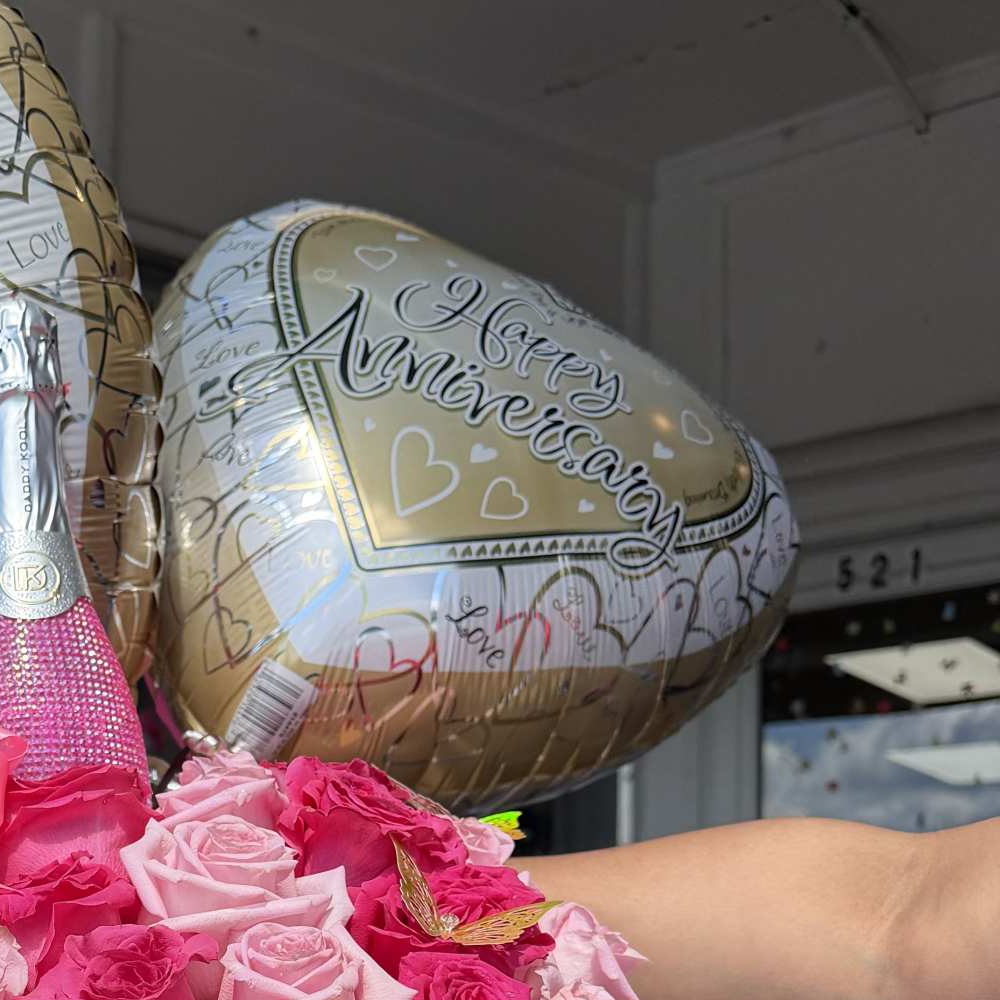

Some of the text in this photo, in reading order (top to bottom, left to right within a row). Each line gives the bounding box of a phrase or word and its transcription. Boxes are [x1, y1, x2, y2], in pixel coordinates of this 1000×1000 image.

[7, 220, 71, 270] Love
[394, 276, 630, 418] Happy
[18, 424, 33, 513] DADDY KOOL
[198, 287, 677, 573] Anniversary
[445, 595, 504, 669] Love
